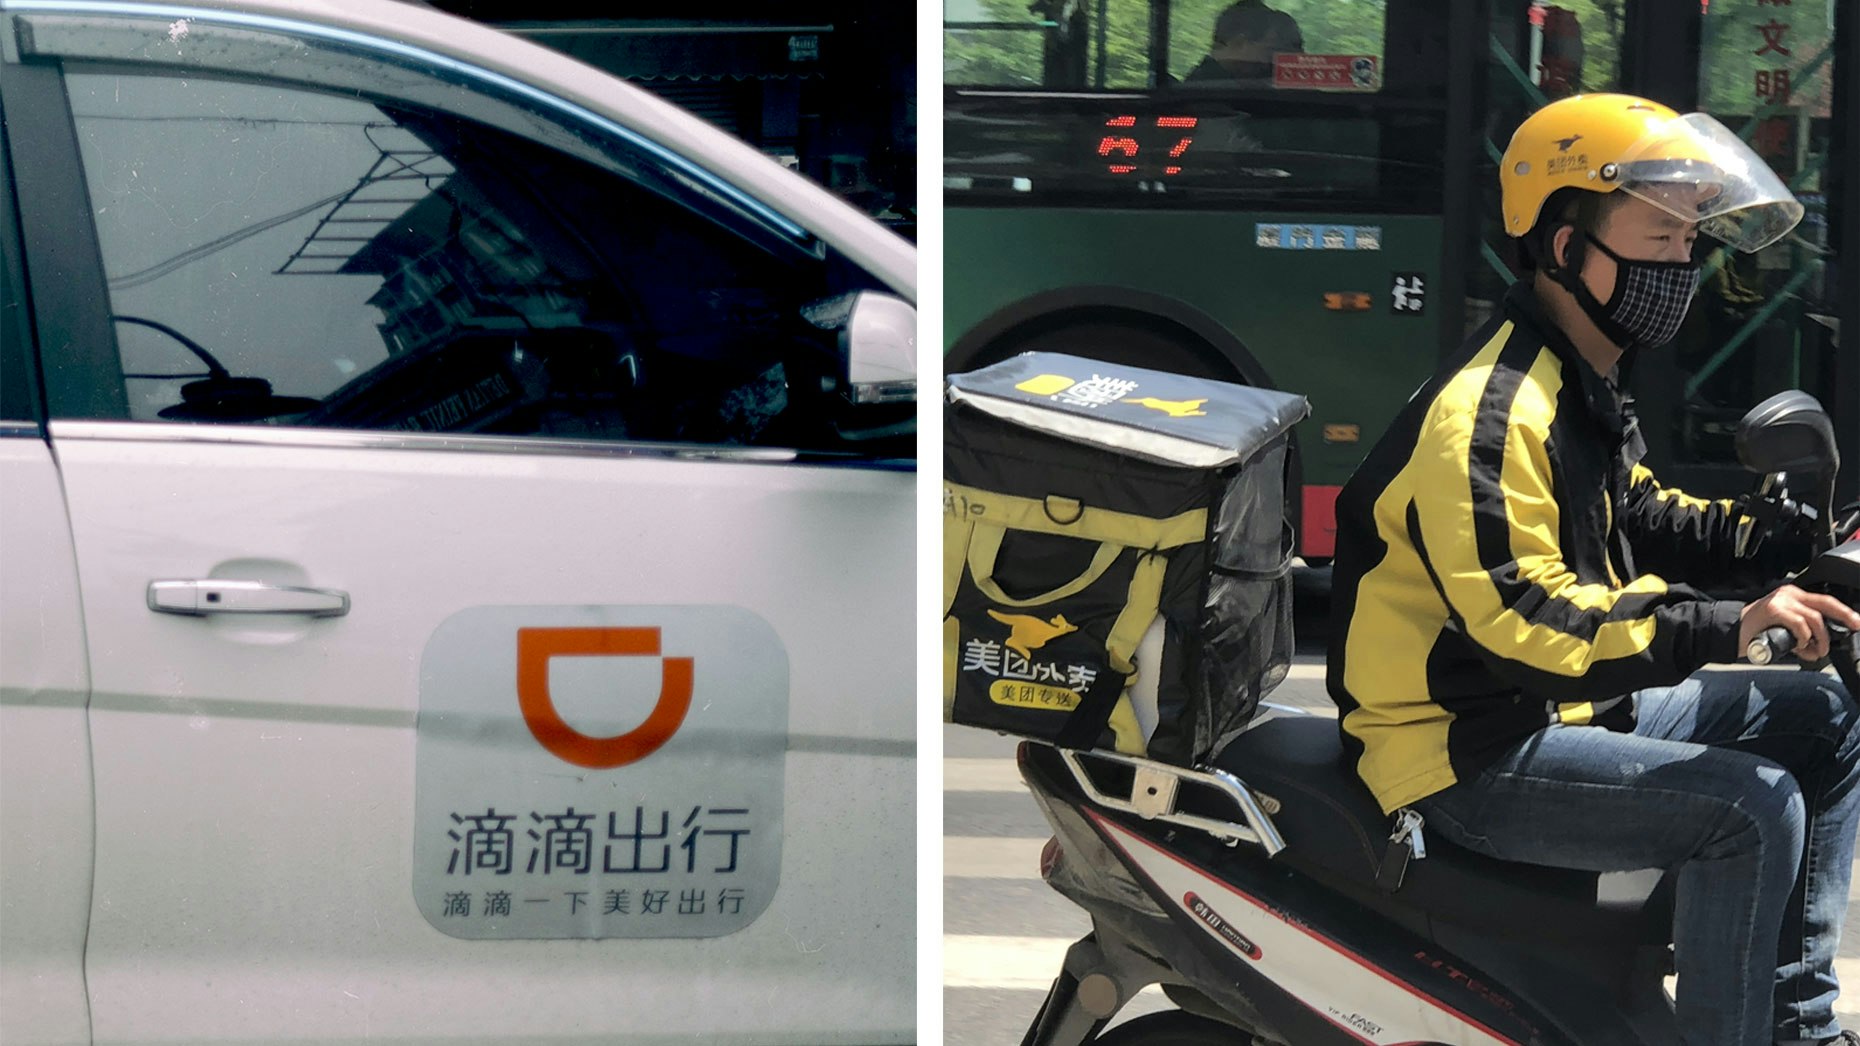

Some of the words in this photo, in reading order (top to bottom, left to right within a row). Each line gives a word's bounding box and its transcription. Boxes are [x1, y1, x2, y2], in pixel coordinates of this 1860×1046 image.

[1099, 116, 1197, 174] 67
[1001, 684, 1073, 707] 美团专送
[446, 805, 751, 876] 滴滴出行
[443, 888, 745, 917] 滴滴一下美好出行
